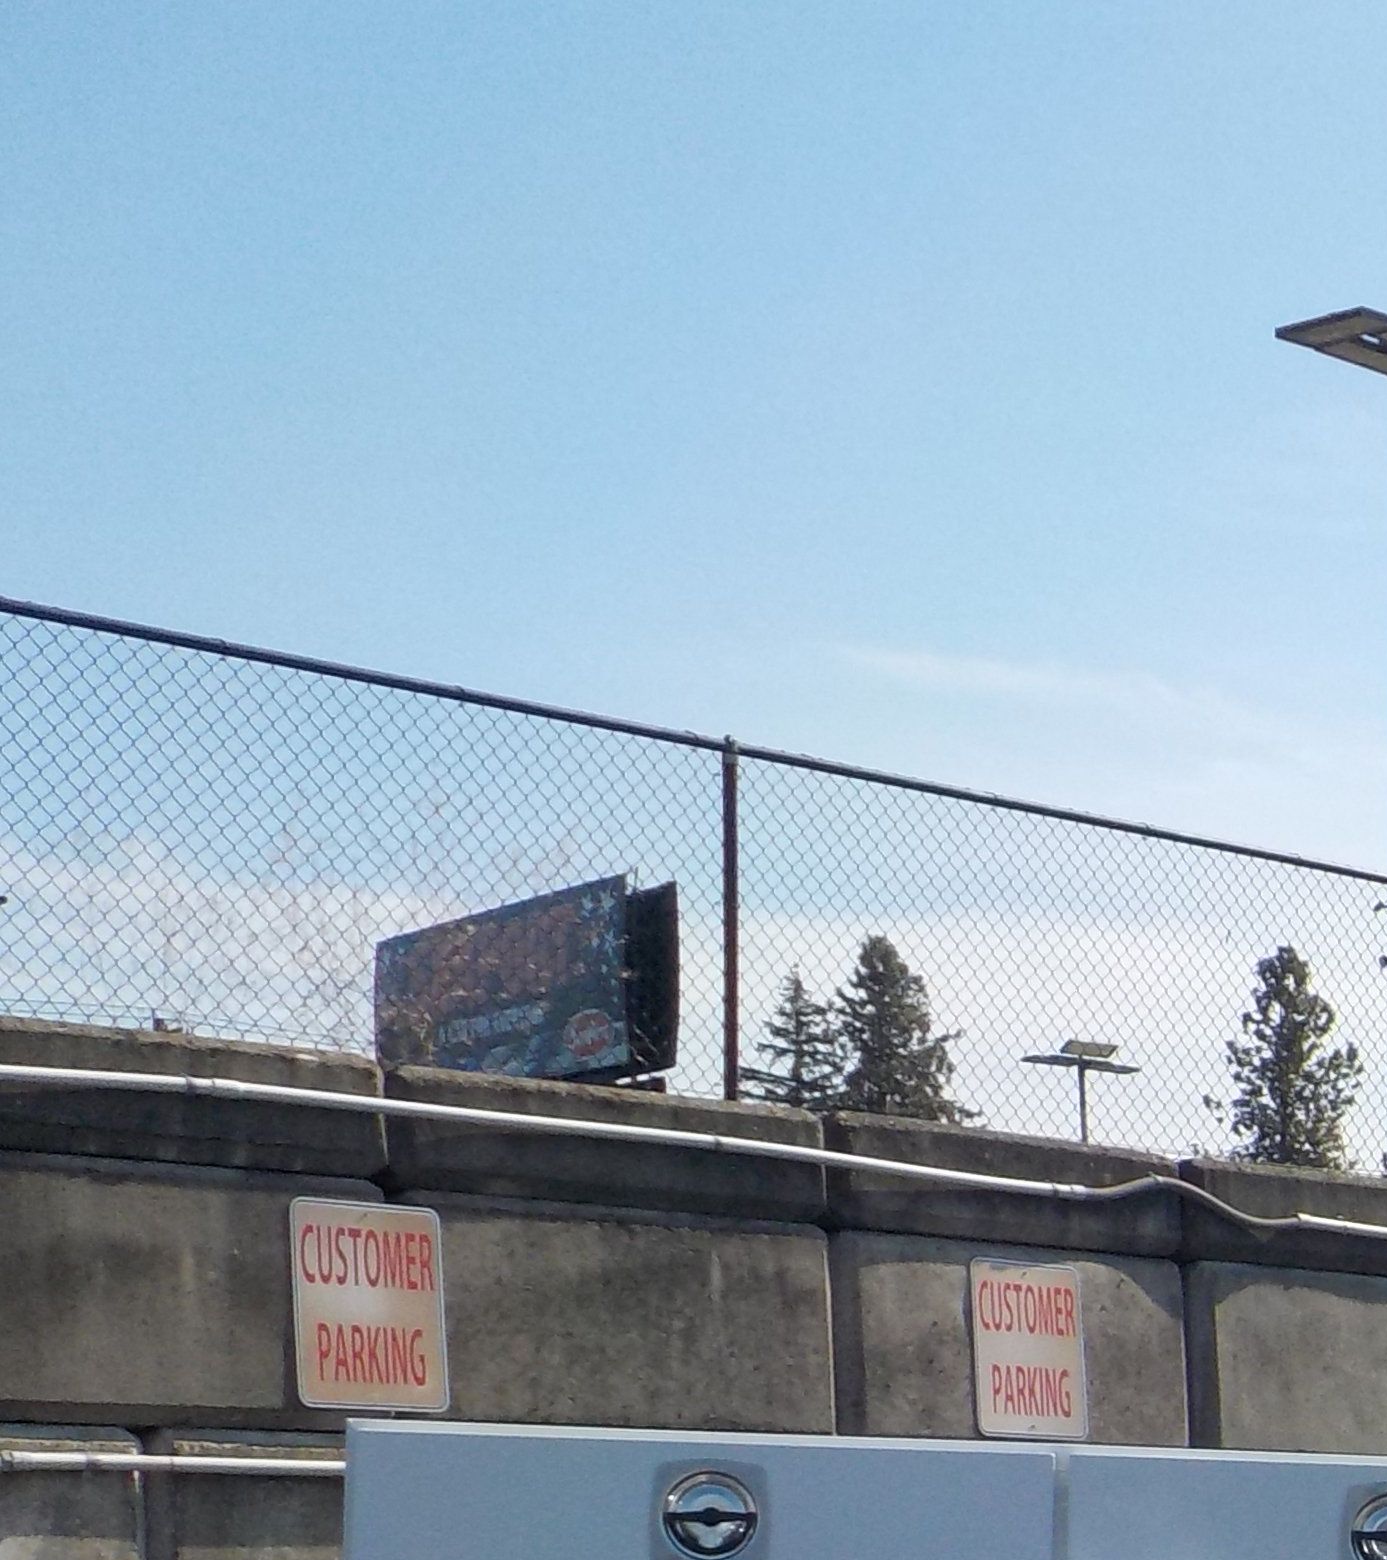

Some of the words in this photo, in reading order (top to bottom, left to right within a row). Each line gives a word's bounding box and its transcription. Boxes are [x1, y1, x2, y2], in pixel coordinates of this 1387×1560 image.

[300, 1223, 435, 1291] CUSTOMER
[978, 1279, 1077, 1338] CUSTOMER
[316, 1322, 427, 1387] PARKING
[991, 1363, 1072, 1418] PARKING
